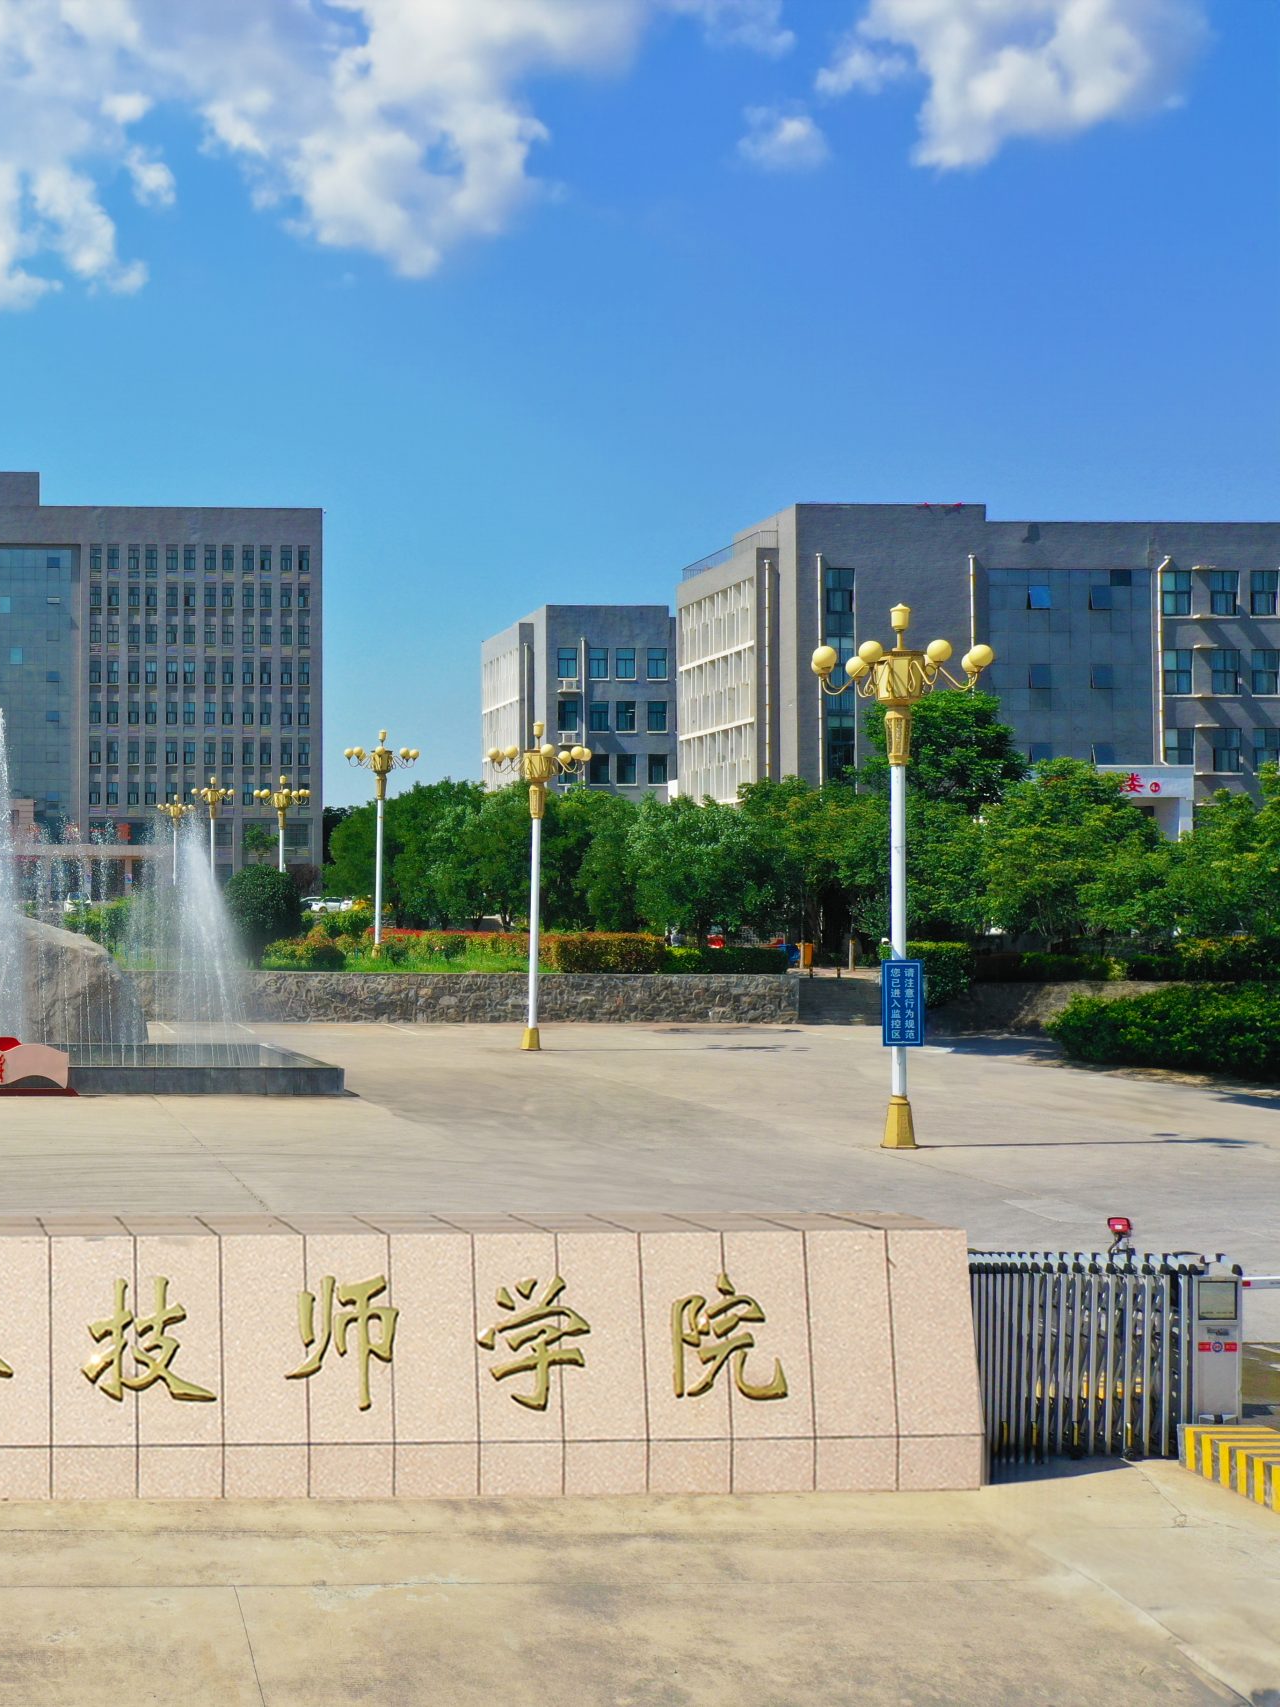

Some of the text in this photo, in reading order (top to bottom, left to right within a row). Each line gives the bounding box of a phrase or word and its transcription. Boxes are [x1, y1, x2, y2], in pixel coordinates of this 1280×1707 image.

[890, 967, 901, 1039] 您已进入监控区
[904, 967, 915, 1039] 请注意行为规范
